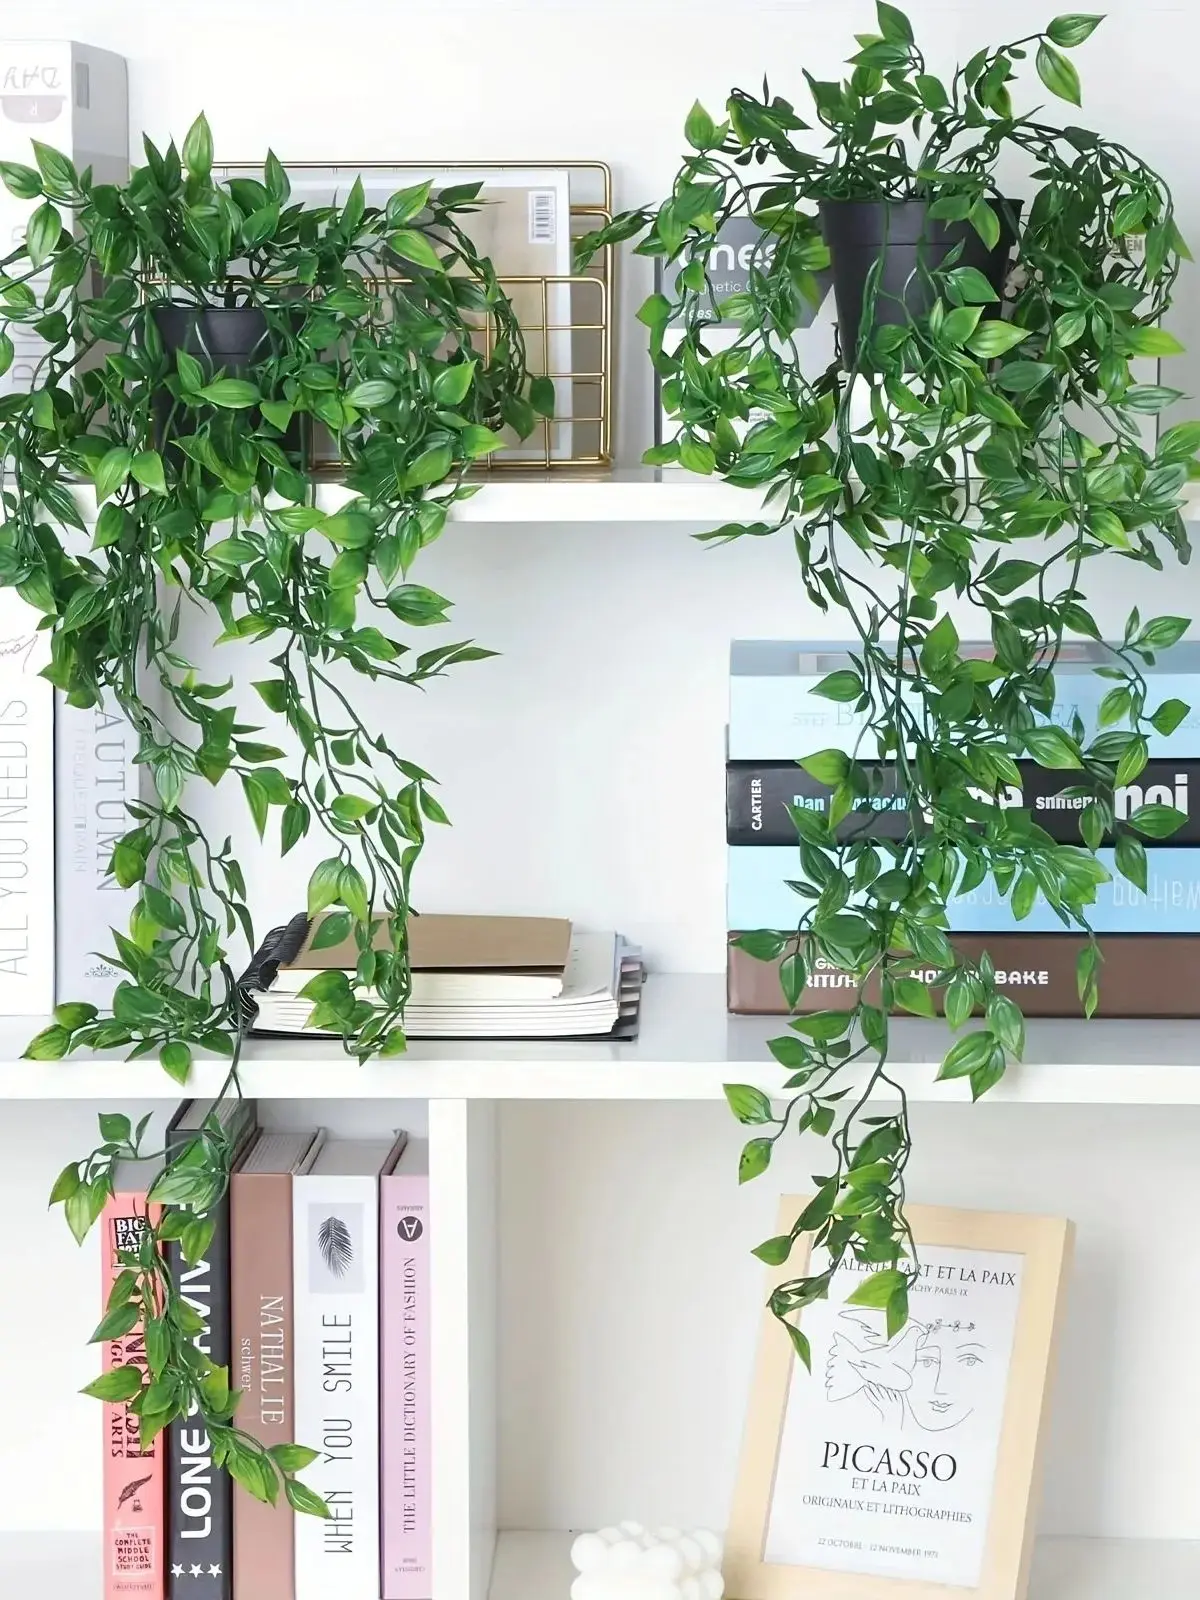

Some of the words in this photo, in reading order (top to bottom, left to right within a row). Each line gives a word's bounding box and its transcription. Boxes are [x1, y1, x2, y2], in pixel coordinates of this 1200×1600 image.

[95, 709, 126, 892] AUTUMN
[751, 778, 763, 831] CARTIER
[793, 794, 825, 811] Dan
[0, 838, 28, 898] YOU
[994, 970, 1049, 985] BAKE
[403, 1258, 416, 1321] FASHION
[937, 1265, 956, 1279] ET
[960, 1268, 977, 1282] LA
[982, 1270, 1016, 1286] PAIX
[322, 1314, 353, 1393] SMILE
[403, 1326, 416, 1346] OF
[241, 1337, 255, 1392] schwer
[260, 1294, 284, 1425] NATHALIE
[403, 1350, 416, 1442] DICTIONARY
[111, 1411, 124, 1458] ARTS
[323, 1418, 353, 1464] YOU
[180, 1429, 212, 1539] LONE
[403, 1447, 416, 1498] LITTLE
[820, 1441, 957, 1482] PICASSO
[802, 1494, 865, 1511] ORIGINAUX
[866, 1502, 881, 1513] ET
[883, 1503, 973, 1523] LITHOGRAPHIES
[851, 1477, 869, 1490] ET
[872, 1480, 888, 1492] LA
[891, 1481, 922, 1496] PAIX
[324, 1491, 353, 1553] WHEN
[403, 1502, 416, 1534] THE
[114, 1538, 152, 1546] COMPLETE
[117, 1546, 150, 1554] MIDDLE
[117, 1555, 150, 1563] SCHOOL
